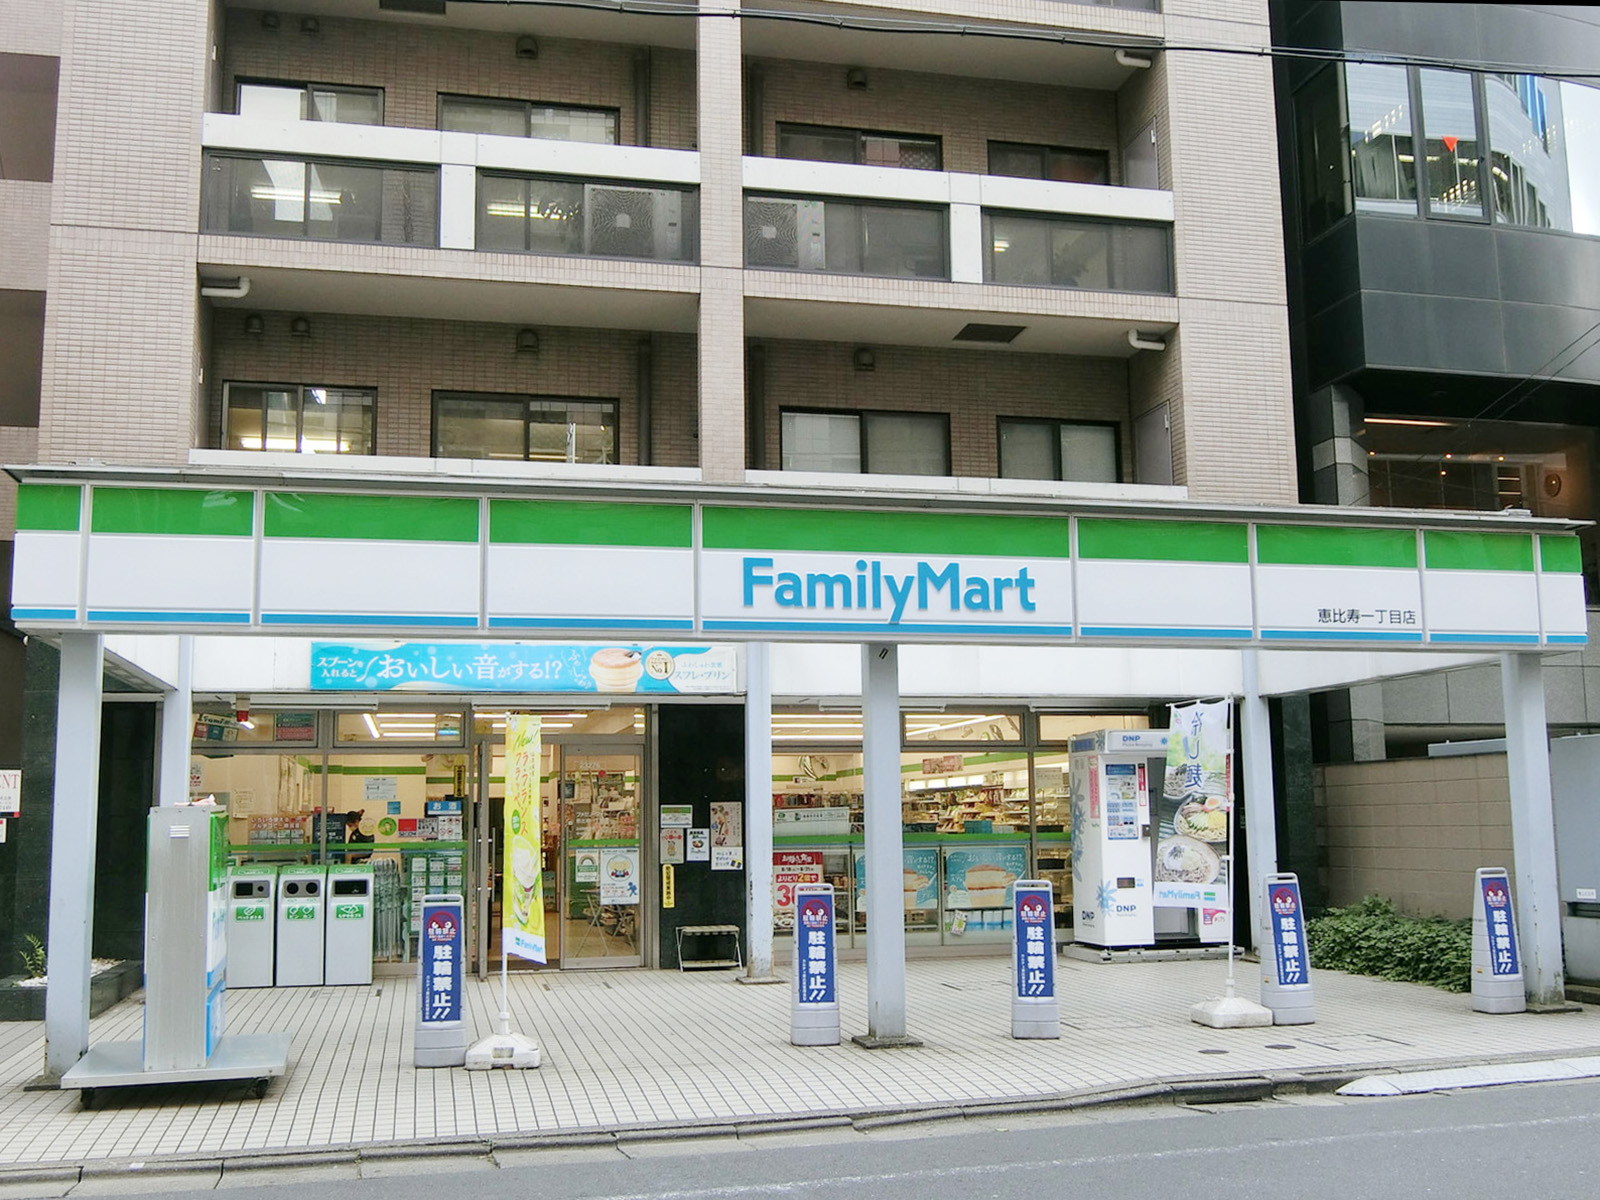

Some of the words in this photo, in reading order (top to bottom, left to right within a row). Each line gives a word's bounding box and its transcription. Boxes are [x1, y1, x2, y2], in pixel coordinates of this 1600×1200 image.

[743, 557, 1036, 624] FamilyMart
[1318, 608, 1416, 625] 恵比寿一丁目店
[322, 669, 358, 678] 入れると
[377, 654, 562, 680] おいしい音がする!?
[777, 884, 795, 907] 3
[1116, 905, 1137, 913] DNP
[808, 930, 827, 1001] 駐輪禁止!!
[1027, 926, 1045, 995] 駐輪禁止!!
[432, 944, 453, 1020] 駐輪禁止!!
